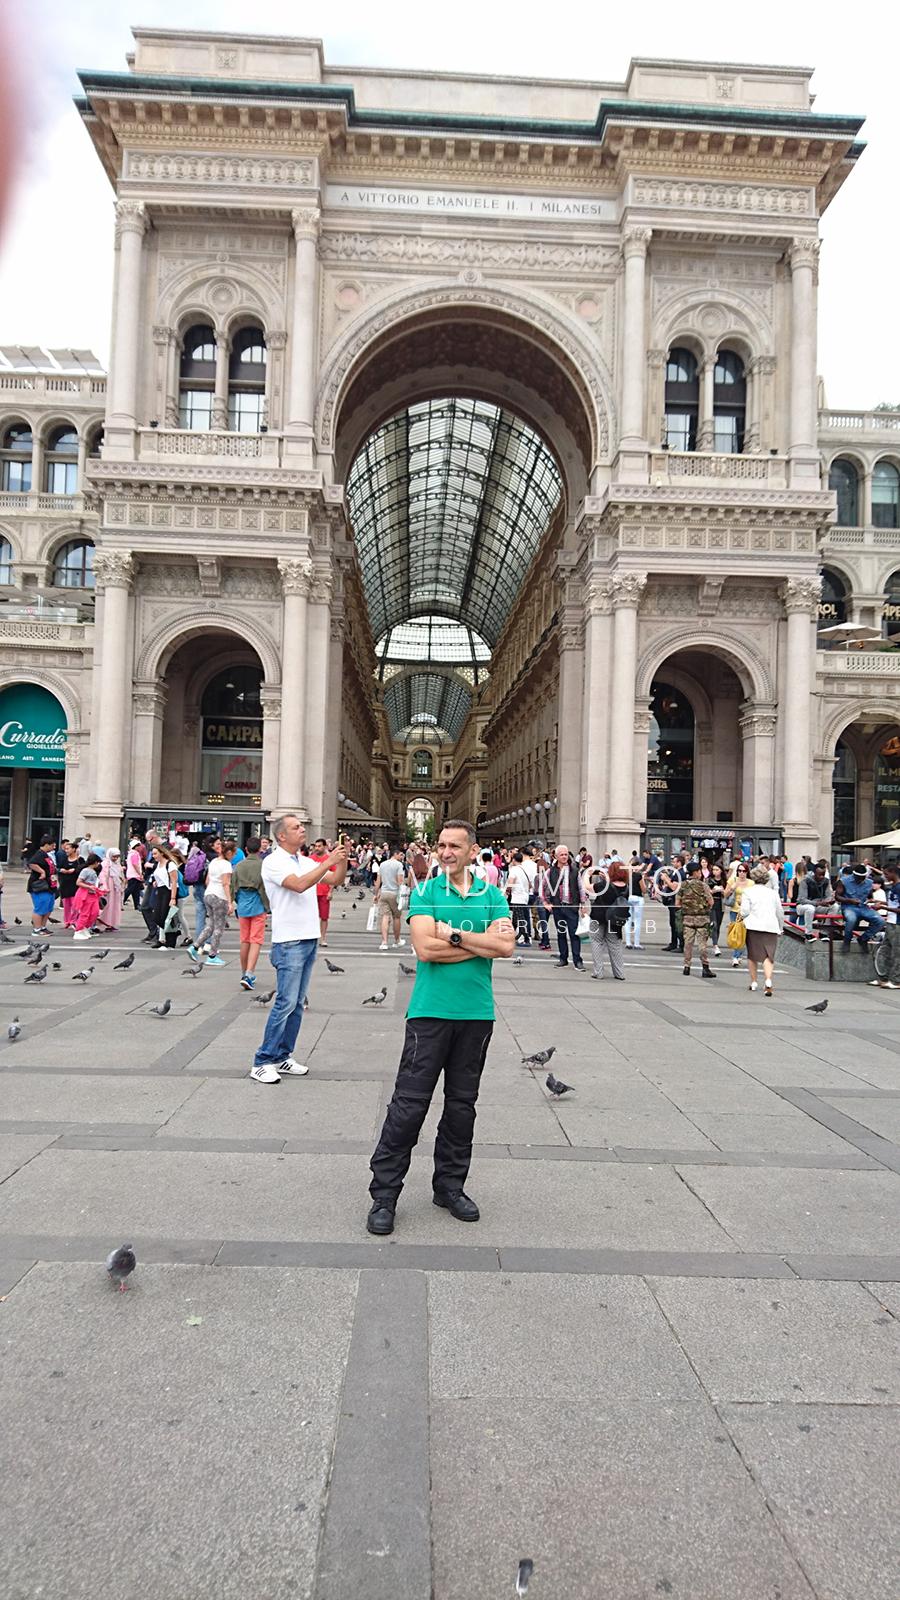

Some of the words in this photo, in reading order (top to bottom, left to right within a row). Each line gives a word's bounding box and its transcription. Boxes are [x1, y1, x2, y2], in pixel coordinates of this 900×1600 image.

[341, 191, 349, 201] A
[358, 192, 419, 204] VITTORIO
[427, 196, 499, 209] EMANUELE
[507, 199, 518, 211] II.
[541, 202, 602, 216] MILANESI
[207, 725, 262, 742] CAMPA
[647, 779, 668, 789] otta
